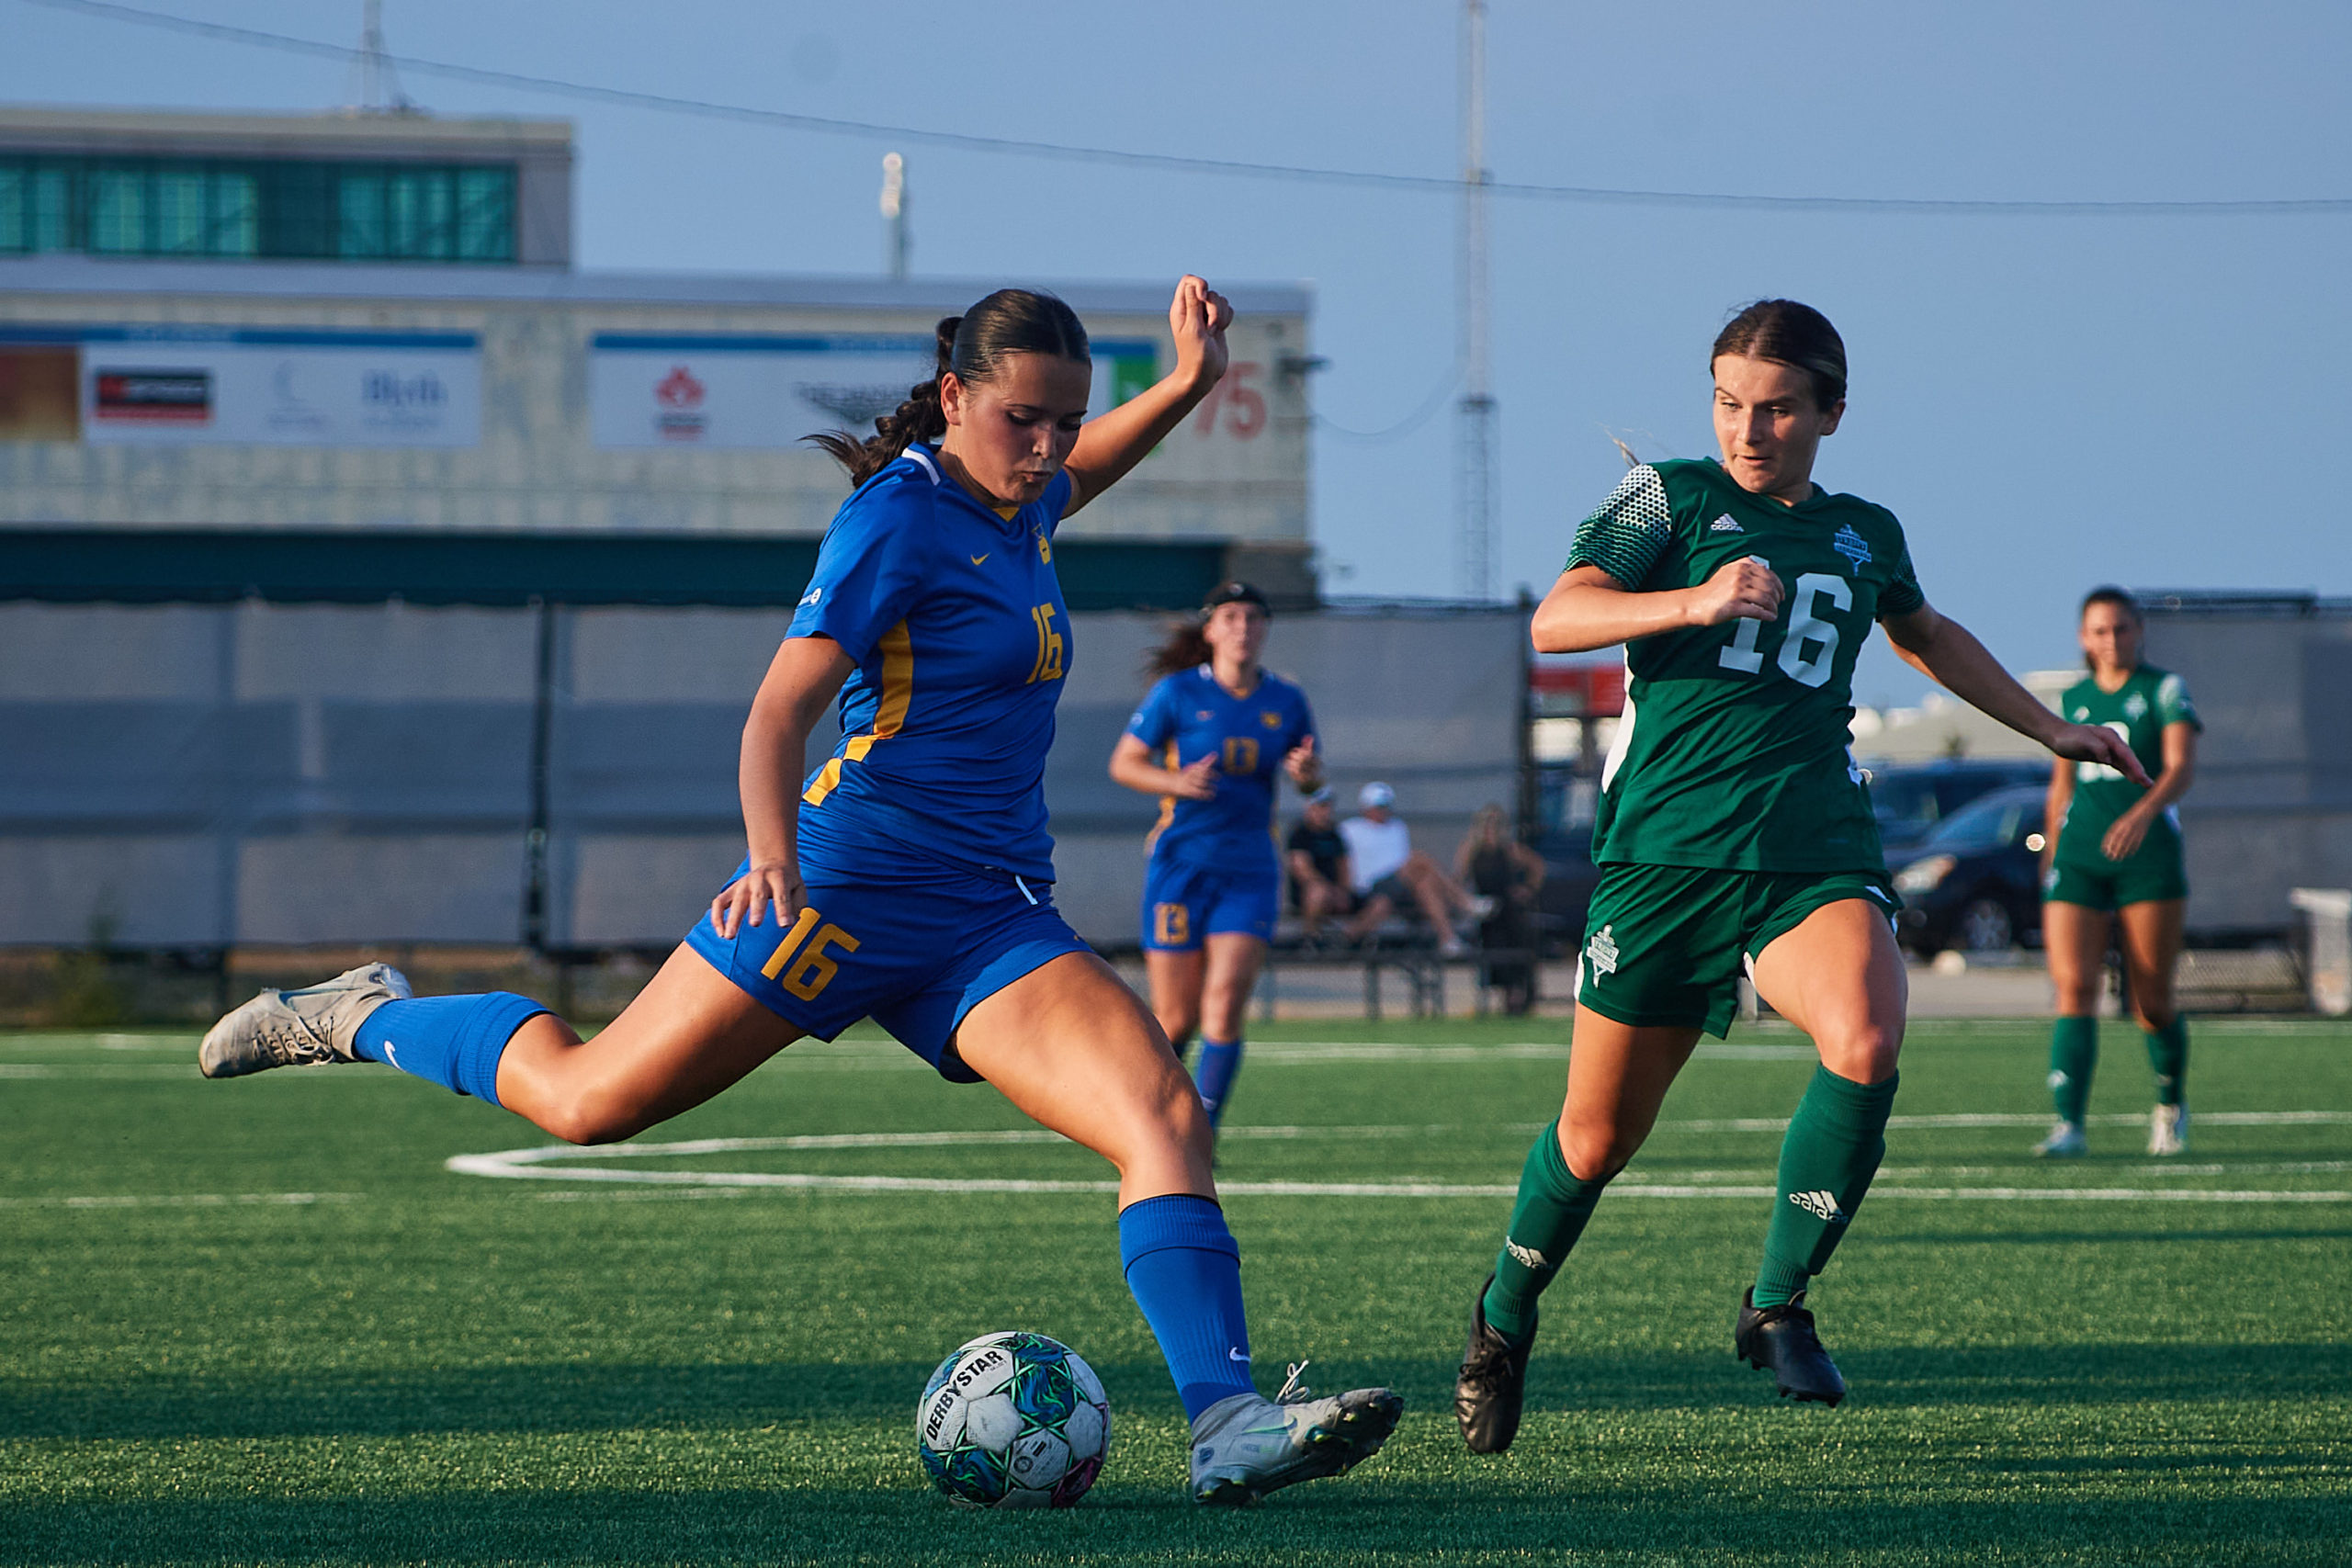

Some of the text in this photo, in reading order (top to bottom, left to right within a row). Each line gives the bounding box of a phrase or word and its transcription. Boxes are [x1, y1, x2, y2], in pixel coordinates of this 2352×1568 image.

[1025, 603, 1063, 684] 16
[1718, 554, 1853, 688] 16
[761, 907, 861, 1001] 16
[1153, 902, 1189, 944] 13
[926, 1350, 1004, 1441] DERBYSTAR
